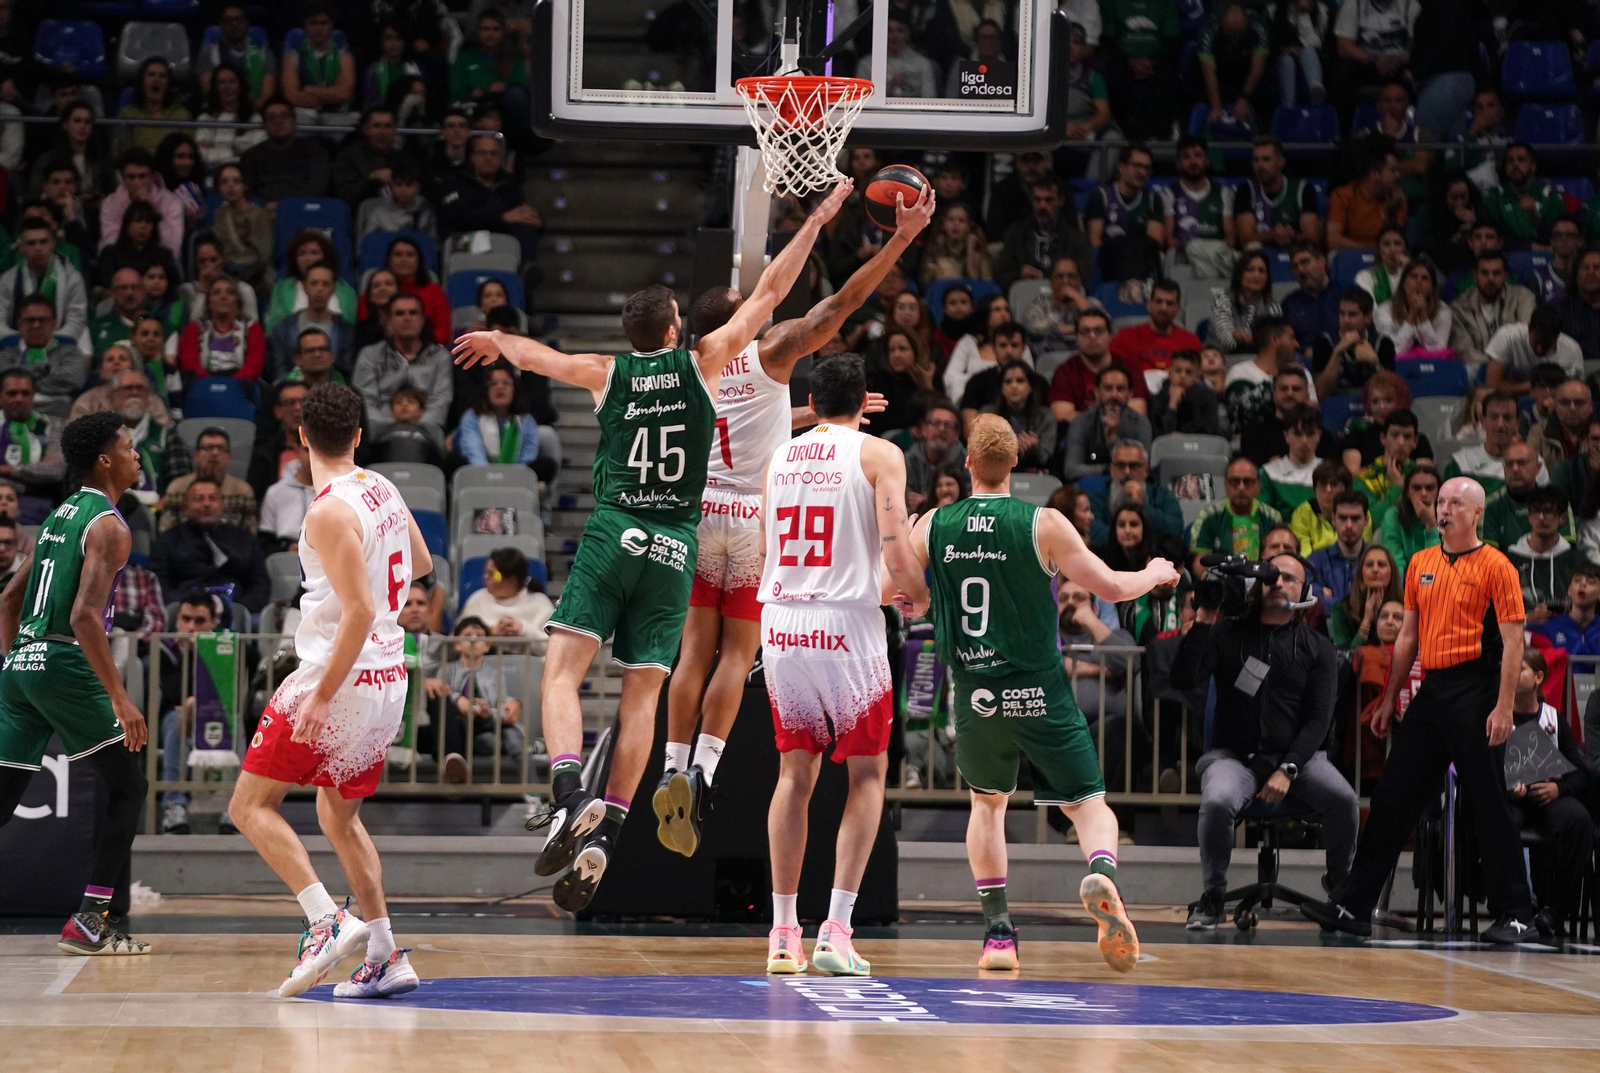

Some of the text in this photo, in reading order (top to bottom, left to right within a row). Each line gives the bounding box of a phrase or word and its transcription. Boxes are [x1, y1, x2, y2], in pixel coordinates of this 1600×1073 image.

[961, 71, 985, 85] liga
[961, 83, 1012, 95] endesa
[631, 372, 680, 392] KRAVISH
[627, 424, 686, 484] 45
[786, 443, 836, 462] ORIOLA
[700, 500, 760, 521] quaflix
[967, 513, 995, 532] DÍAZ
[653, 533, 688, 555] COSTA
[776, 505, 834, 567] 29
[647, 552, 684, 573] MÁLAGA
[650, 543, 686, 564] DEL SOL
[32, 558, 55, 619] 11
[960, 576, 990, 637] 9
[19, 642, 48, 653] COSTA
[767, 627, 850, 652] Aquaflix
[12, 661, 46, 671] MÁLAGA
[14, 653, 47, 662] DEL SOL
[1001, 686, 1046, 700] COSTA
[1002, 698, 1047, 709] DEL SOL
[1003, 708, 1047, 718] MÁLAGA
